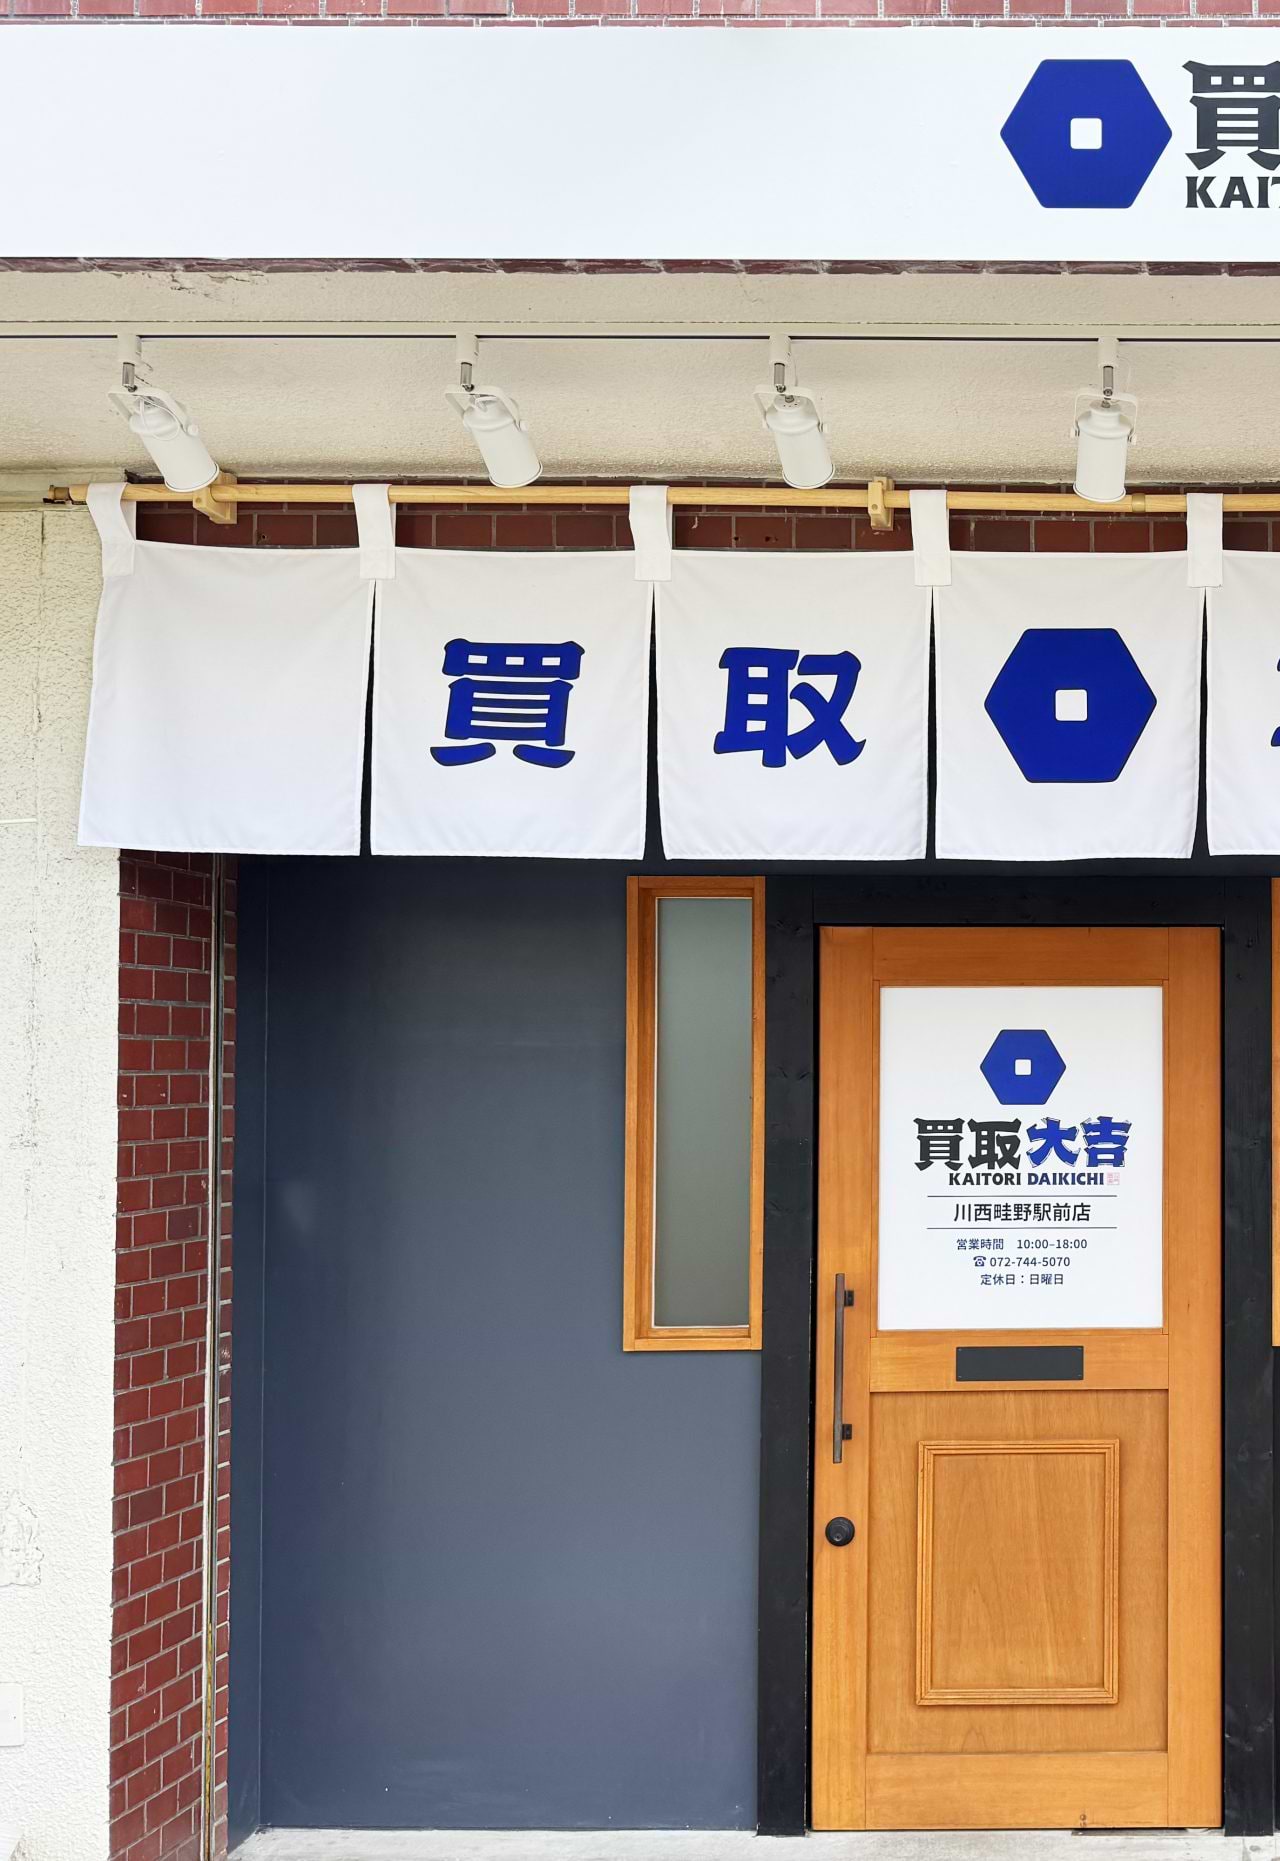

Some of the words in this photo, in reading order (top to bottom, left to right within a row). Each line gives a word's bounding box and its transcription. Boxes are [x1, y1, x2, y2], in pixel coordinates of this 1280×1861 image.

[913, 1116, 1132, 1171] 買取大吉
[949, 1173, 1021, 1185] KAITORI
[1028, 1173, 1104, 1185] DAIKICHI
[954, 1203, 1090, 1221] 川西畦野駅前店
[956, 1238, 1004, 1250] 営業時間
[989, 1256, 1071, 1267] 072-744-5070
